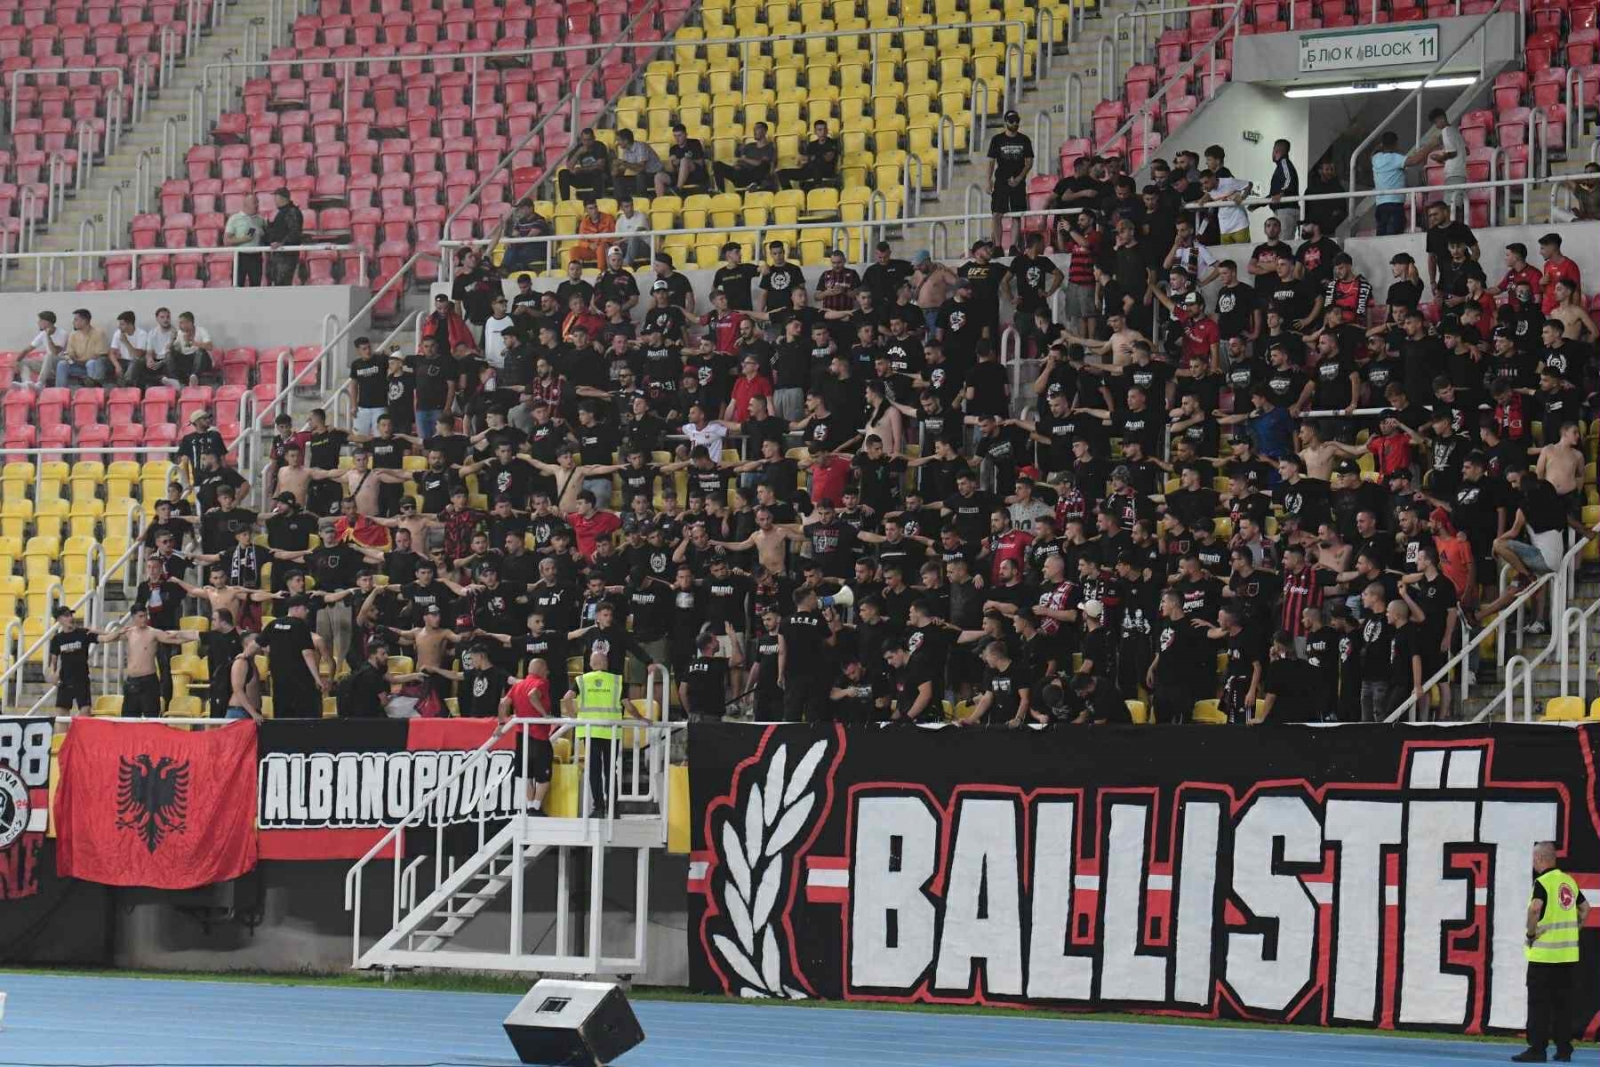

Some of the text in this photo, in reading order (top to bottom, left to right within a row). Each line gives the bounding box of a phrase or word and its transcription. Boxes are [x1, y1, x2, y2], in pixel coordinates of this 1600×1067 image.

[1307, 46, 1353, 63] БЛОК
[1364, 41, 1412, 58] BLOCK
[1418, 36, 1434, 57] 11
[852, 750, 1558, 1029] BALLISTËT
